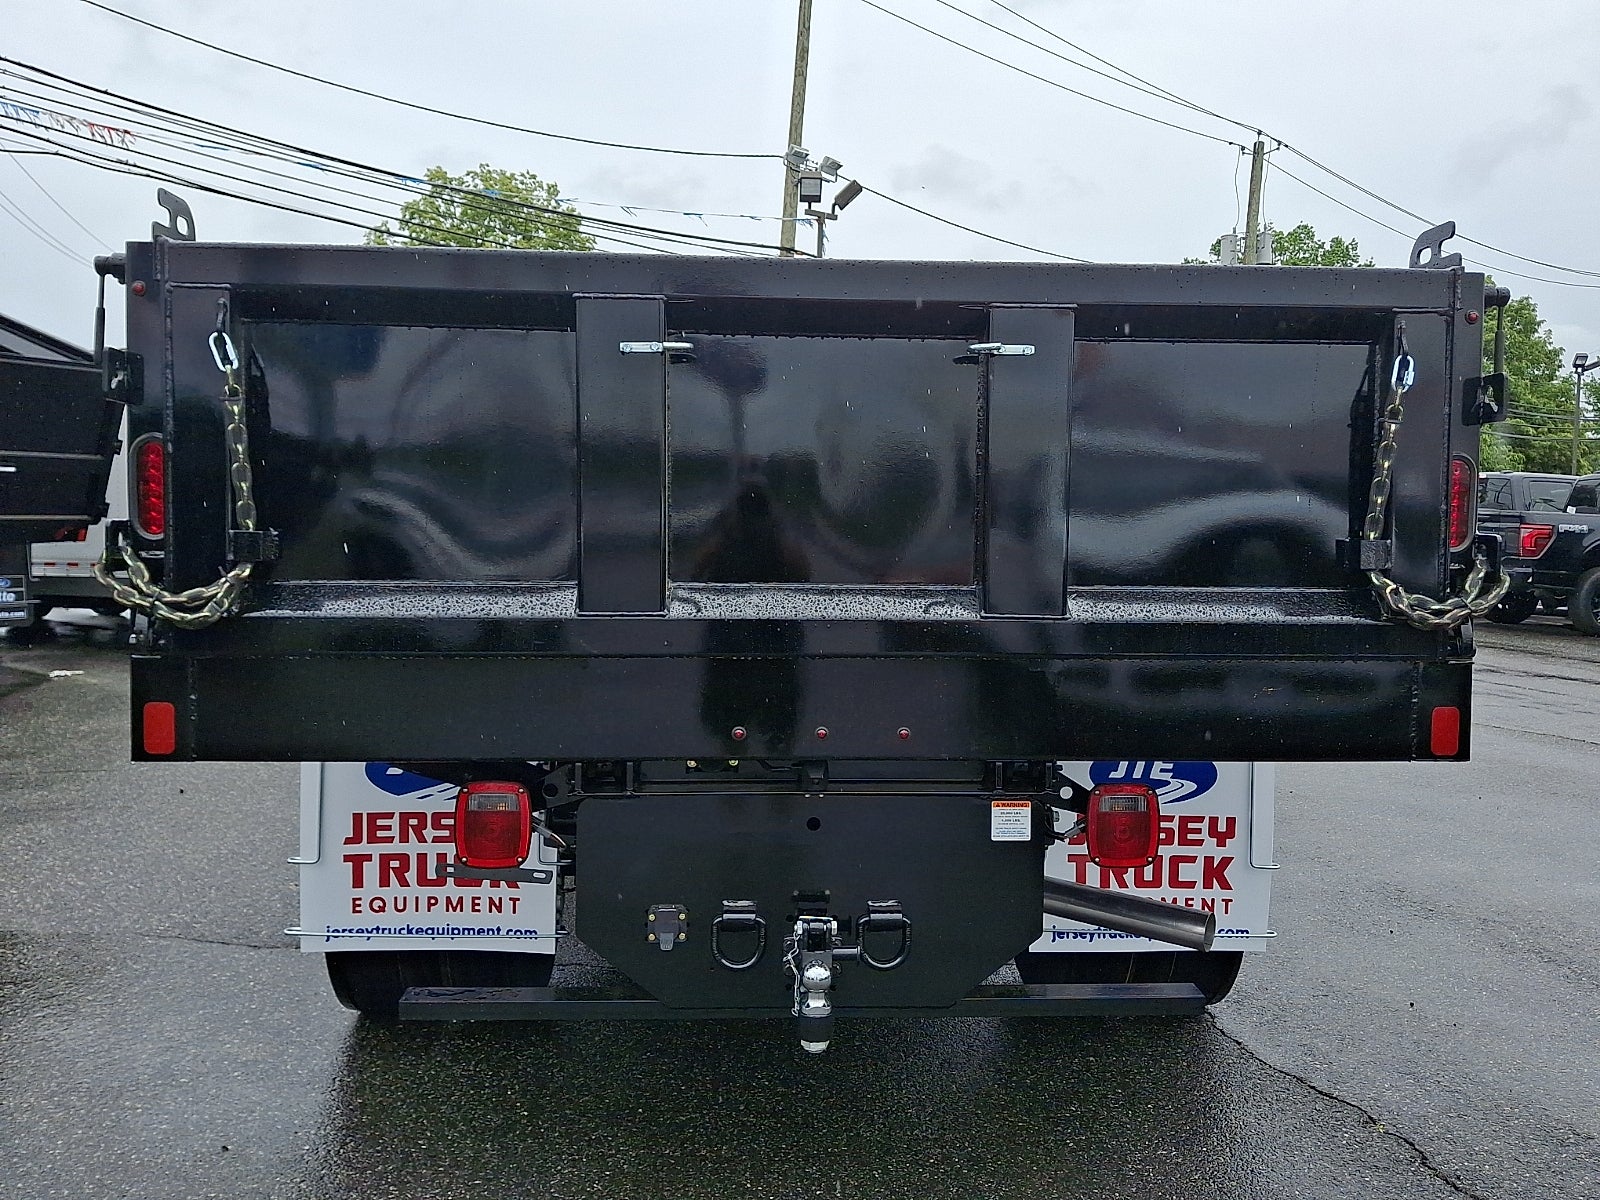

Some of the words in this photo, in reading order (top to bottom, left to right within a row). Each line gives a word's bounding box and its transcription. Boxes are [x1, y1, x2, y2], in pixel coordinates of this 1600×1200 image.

[343, 812, 455, 845] JERS
[1067, 854, 1235, 890] TRUCK
[351, 895, 521, 914] EQUIPMENT
[325, 923, 538, 942] jerseytruckequipmentcom
